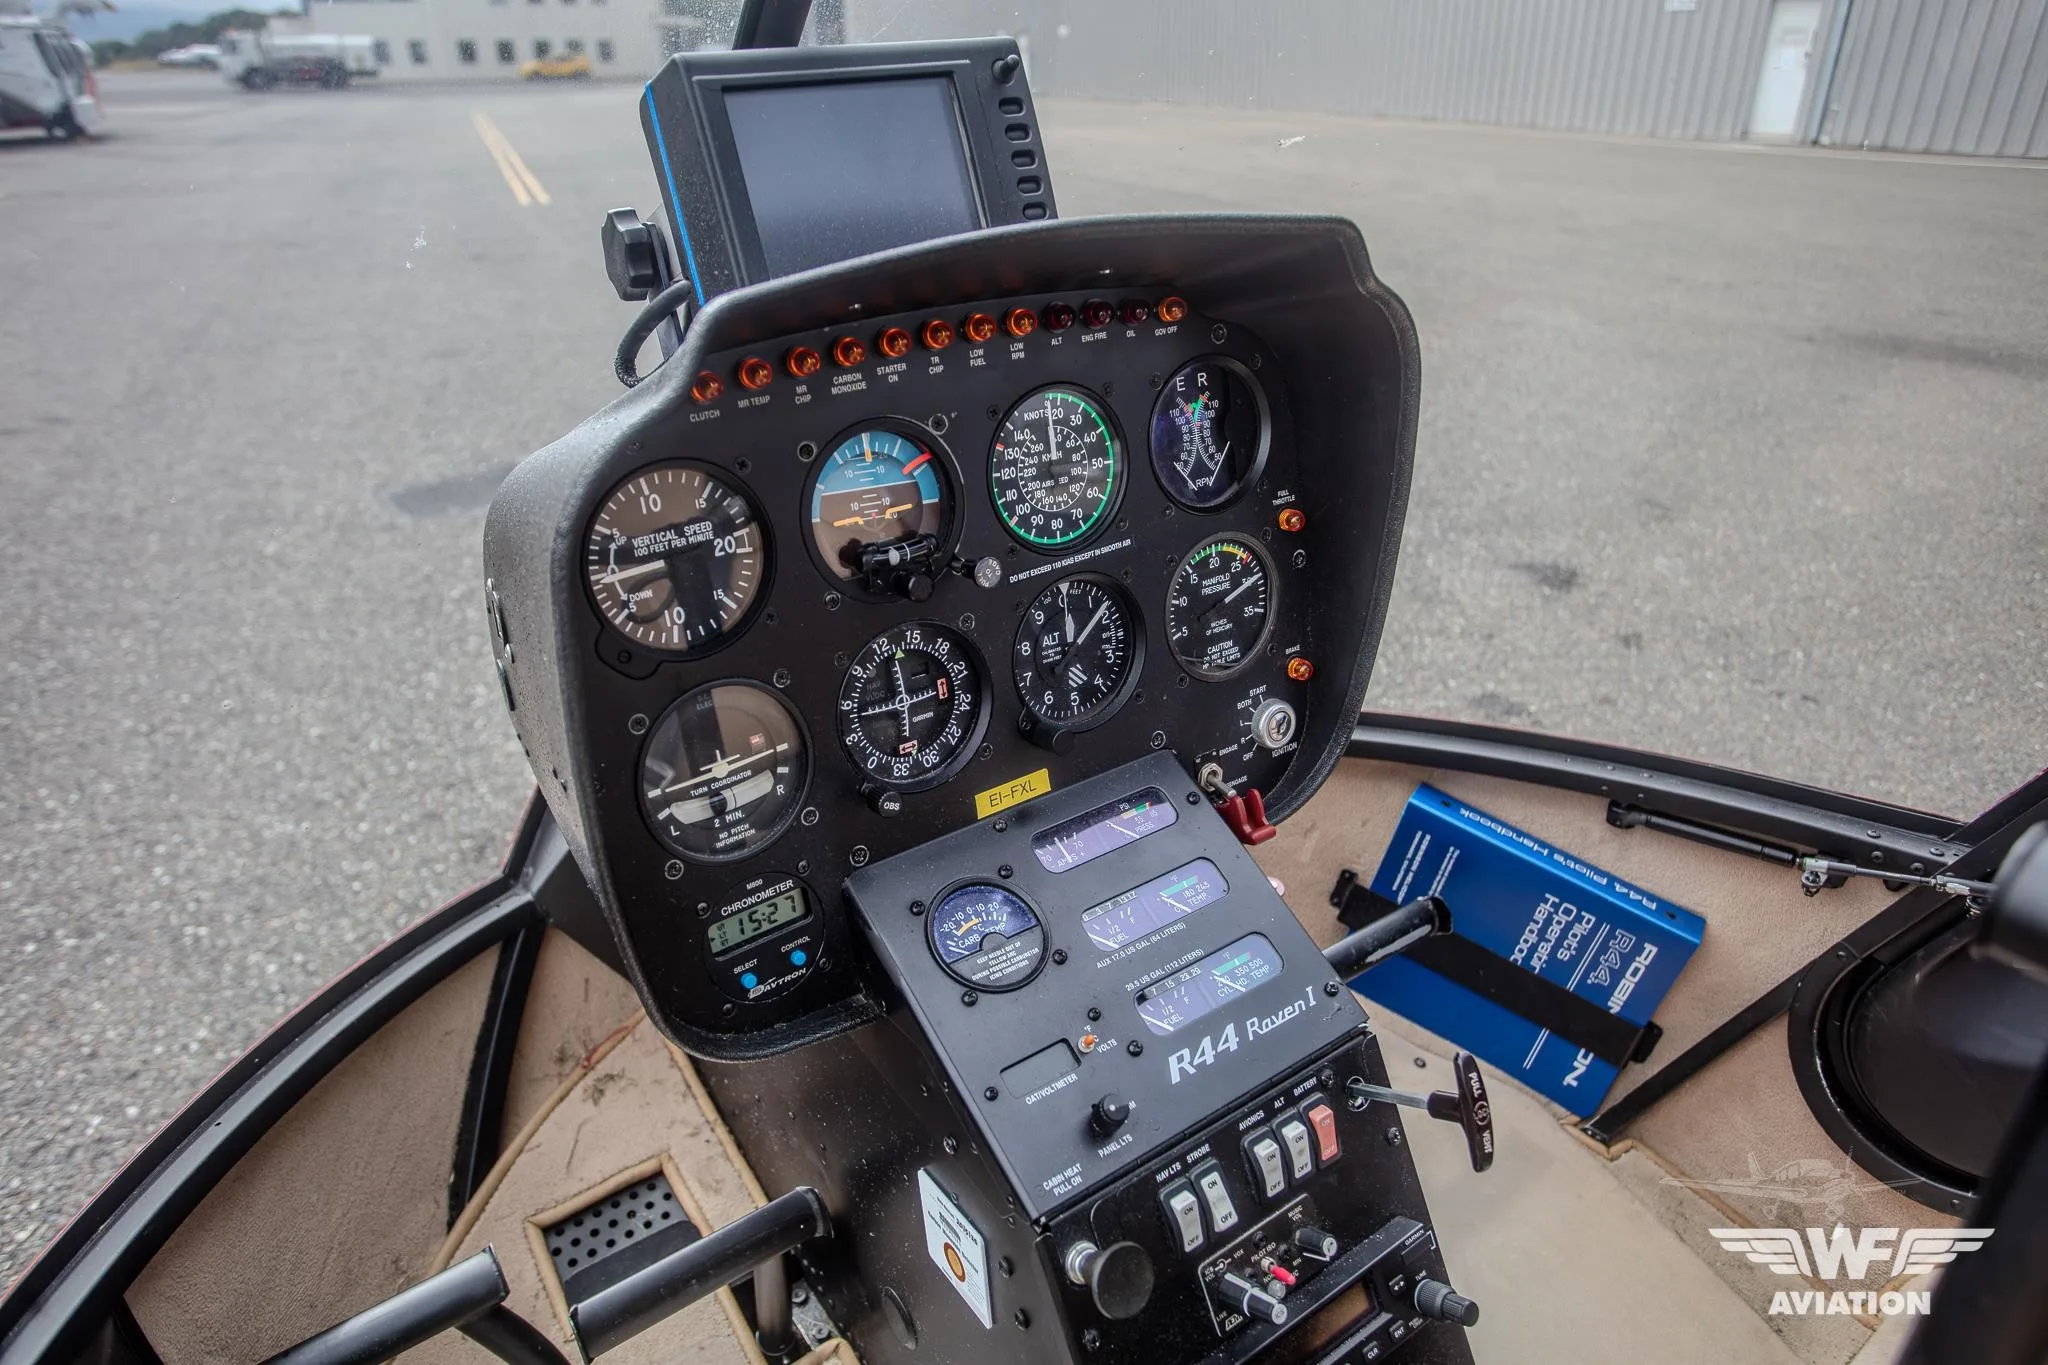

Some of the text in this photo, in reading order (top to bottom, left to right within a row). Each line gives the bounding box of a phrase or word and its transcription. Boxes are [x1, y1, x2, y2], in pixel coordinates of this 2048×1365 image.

[1126, 330, 1136, 338] OIL
[1155, 325, 1178, 336] GOV OFF
[1051, 338, 1062, 346] ALT
[1082, 332, 1107, 343] ENG FIRE
[969, 348, 984, 357] LOW
[1010, 342, 1024, 351] LOW
[930, 356, 939, 364] TR
[970, 357, 986, 367] FUEL
[1012, 351, 1024, 360] RPM
[876, 363, 906, 376] STARTER
[929, 365, 944, 374] CHIP
[833, 372, 862, 385] CARBON
[888, 374, 898, 383] ON
[1177, 372, 1208, 391] E R
[796, 385, 808, 393] MR
[832, 381, 867, 395] MONOXIDE
[738, 395, 770, 408] MR TEMP
[795, 394, 811, 404] CHIP
[690, 409, 720, 422] CLUTCH
[1024, 409, 1049, 421] KNOTS
[1070, 414, 1082, 426] 30
[1014, 429, 1030, 441] 140
[1084, 432, 1096, 443] 40
[1004, 448, 1019, 460] 130
[1092, 457, 1103, 469] 50
[1001, 468, 1016, 480] 120
[1086, 486, 1098, 498] 60
[640, 494, 661, 514] 10
[1272, 495, 1295, 506] THROTTLE
[1016, 503, 1030, 516] 100
[1071, 508, 1082, 520] 70
[1031, 514, 1044, 526] 90
[1051, 518, 1063, 529] 80
[632, 520, 713, 548] VERTICAL SPEED
[616, 536, 627, 546] UP
[634, 531, 714, 557] 100 FEET PER MINUTE
[714, 536, 735, 557] 20
[1019, 572, 1030, 581] NOT
[1030, 564, 1052, 576] EXCEED
[1052, 561, 1062, 569] 110
[1062, 558, 1074, 566] KIAS
[1075, 551, 1094, 563] EXCEPT
[1101, 541, 1122, 554] SMOOTH
[1209, 557, 1219, 568] 20
[1231, 561, 1241, 572] 25
[1202, 573, 1230, 587] MANIFOLD
[629, 589, 653, 601] DOWN
[1202, 582, 1231, 595] PRESSURE
[665, 606, 685, 627] 10
[906, 630, 920, 643] 15
[1042, 632, 1059, 647] ALT
[873, 638, 890, 655] 12
[935, 637, 950, 654] 18
[1208, 640, 1233, 654] CAUTION
[1286, 645, 1300, 654] BRAKE
[953, 661, 968, 679] 21
[1249, 685, 1266, 696] START
[1237, 699, 1252, 709] BOTH
[912, 711, 934, 722] GARMIN
[1219, 744, 1238, 756] ENGAGE
[1243, 752, 1253, 761] OFF
[1272, 742, 1298, 758] IGNITION
[690, 770, 752, 797] TURN COORDINATOR
[989, 780, 1037, 807] EI-FXL
[884, 802, 900, 810] OBS
[714, 810, 745, 828] 2 MIN.
[719, 823, 749, 840] NO PITCH
[1460, 807, 1548, 856] Handbook
[716, 829, 756, 848] INFORMATION
[1554, 853, 1608, 886] Pilot's
[746, 879, 762, 890] M800
[721, 879, 794, 916] CHRONOMETER
[988, 902, 999, 912] 20
[738, 895, 796, 935] 15:27
[958, 922, 1006, 948] CARB TEMP
[1510, 893, 1560, 966] Handboo
[1557, 911, 1596, 961] Pilot's
[781, 936, 810, 952] CONTROL
[1096, 923, 1186, 968] AUX 17.0 US GAL (64 LITERS)
[734, 959, 758, 974] SELECT
[989, 956, 1006, 966] YELLOW
[1125, 949, 1204, 991] 29.5 US GAL (112 LITERS)
[748, 968, 806, 999] DAVTRON
[1168, 986, 1316, 1085] R44 Raven I
[1096, 1039, 1117, 1052] VOLTS
[1025, 1073, 1078, 1105] OAT/VOLTMETER
[1294, 1077, 1317, 1096] BATTERY
[1468, 1072, 1482, 1098] PULL
[1274, 1097, 1285, 1108] ALT
[1239, 1110, 1264, 1130] AVIONICS
[1099, 1133, 1133, 1157] PANEL LTS
[1296, 1135, 1304, 1143] ON
[1482, 1129, 1493, 1153] VENT
[1186, 1144, 1210, 1163] STROBE
[1324, 1146, 1335, 1155] OFF
[1267, 1153, 1276, 1162] ON
[1156, 1163, 1181, 1182] NAV LTS
[1298, 1163, 1308, 1172] OFF
[1042, 1163, 1082, 1190] CABIN HEAT
[1053, 1176, 1082, 1196] PULL ON
[1208, 1180, 1217, 1189] ON
[1270, 1182, 1282, 1191] OFF
[1184, 1206, 1194, 1215] ON
[1221, 1212, 1233, 1223] OFF
[1188, 1236, 1200, 1246] OFF
[1405, 1229, 1424, 1246] GARMIN
[1233, 1249, 1244, 1258] VOX
[1251, 1242, 1276, 1262] PILOT ISO
[1394, 1327, 1404, 1338] ENT
[1368, 1348, 1378, 1359] CLR
